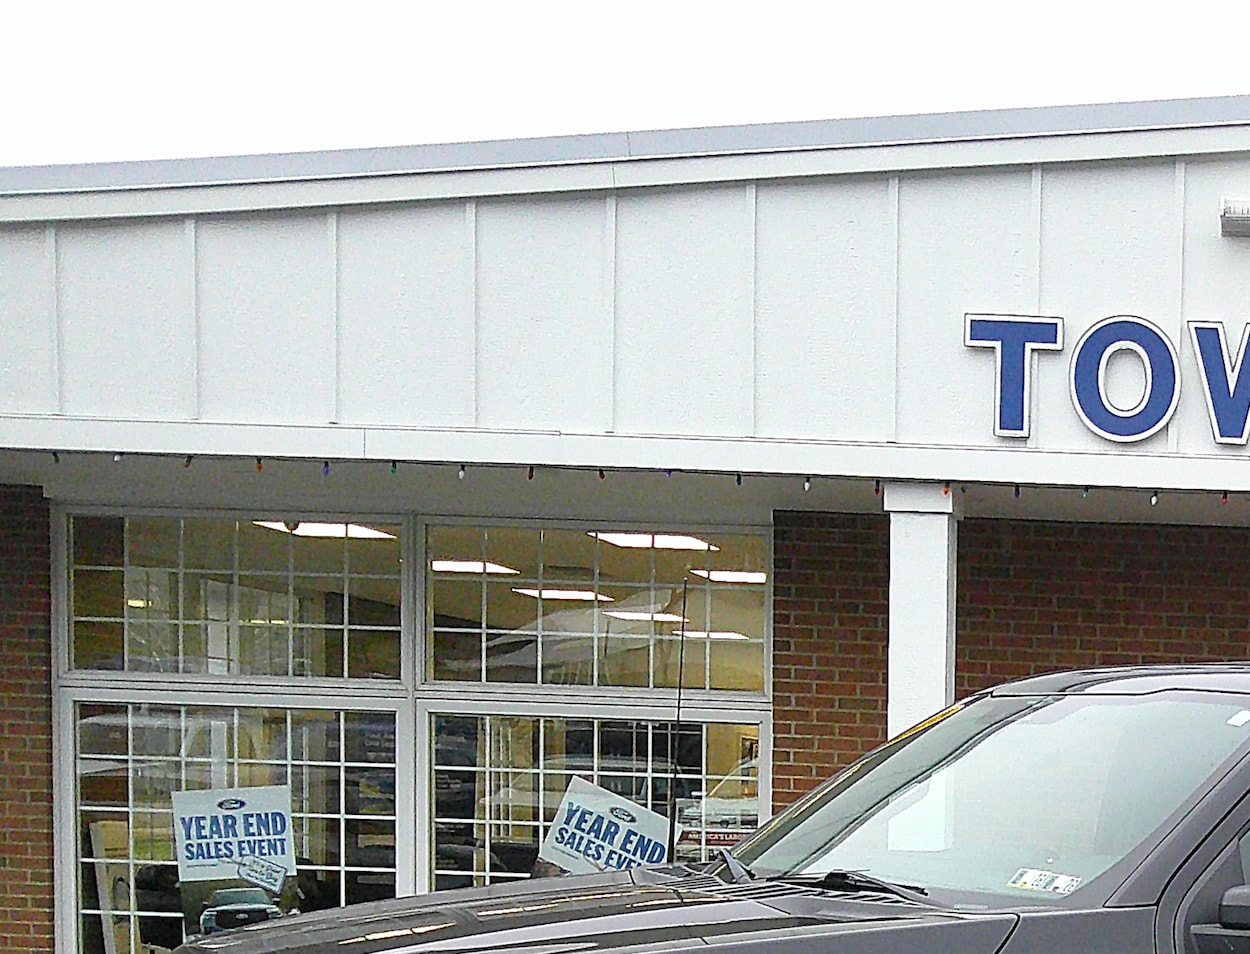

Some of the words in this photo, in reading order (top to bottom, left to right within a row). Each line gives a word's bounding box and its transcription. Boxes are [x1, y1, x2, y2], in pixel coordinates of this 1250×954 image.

[180, 814, 238, 841] YEAR
[243, 811, 287, 837] END
[563, 802, 620, 846] YEAR
[620, 828, 666, 863] END
[185, 840, 234, 861] SALES
[238, 838, 287, 858] EVENT
[555, 827, 605, 861] SALES
[604, 849, 642, 869] EVE
